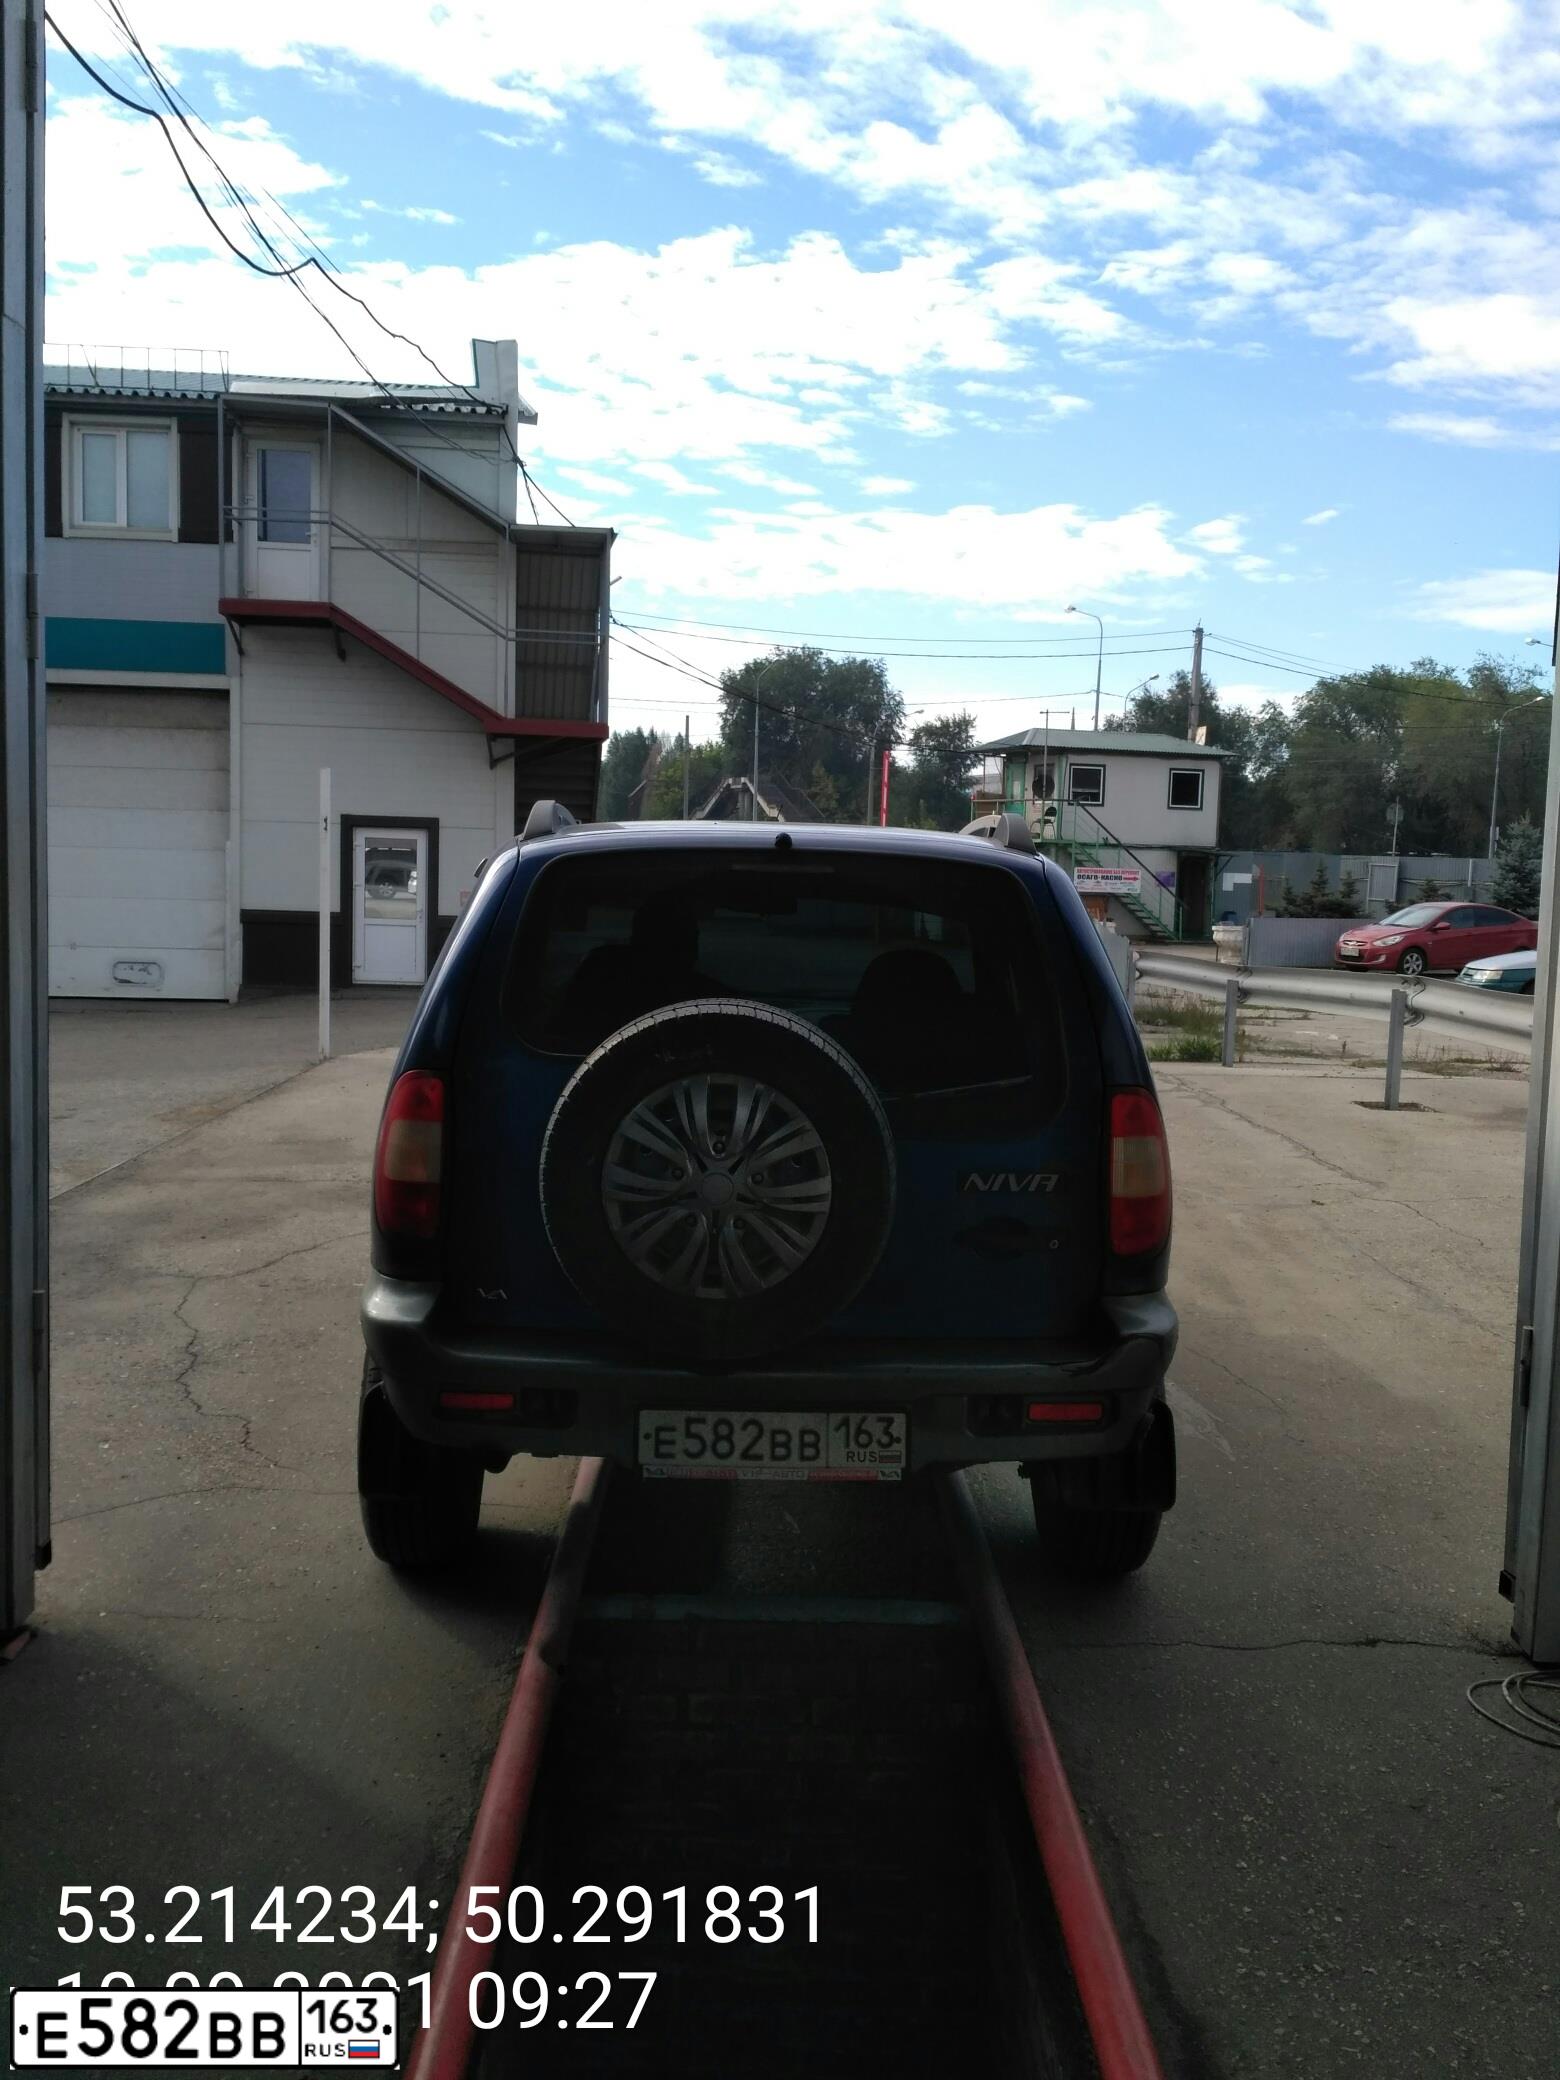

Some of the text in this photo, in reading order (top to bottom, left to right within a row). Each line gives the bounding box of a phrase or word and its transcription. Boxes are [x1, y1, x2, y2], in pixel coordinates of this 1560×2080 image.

[963, 1173, 1059, 1192] NIVA
[834, 1415, 896, 1449] 163
[846, 1451, 878, 1463] RUS
